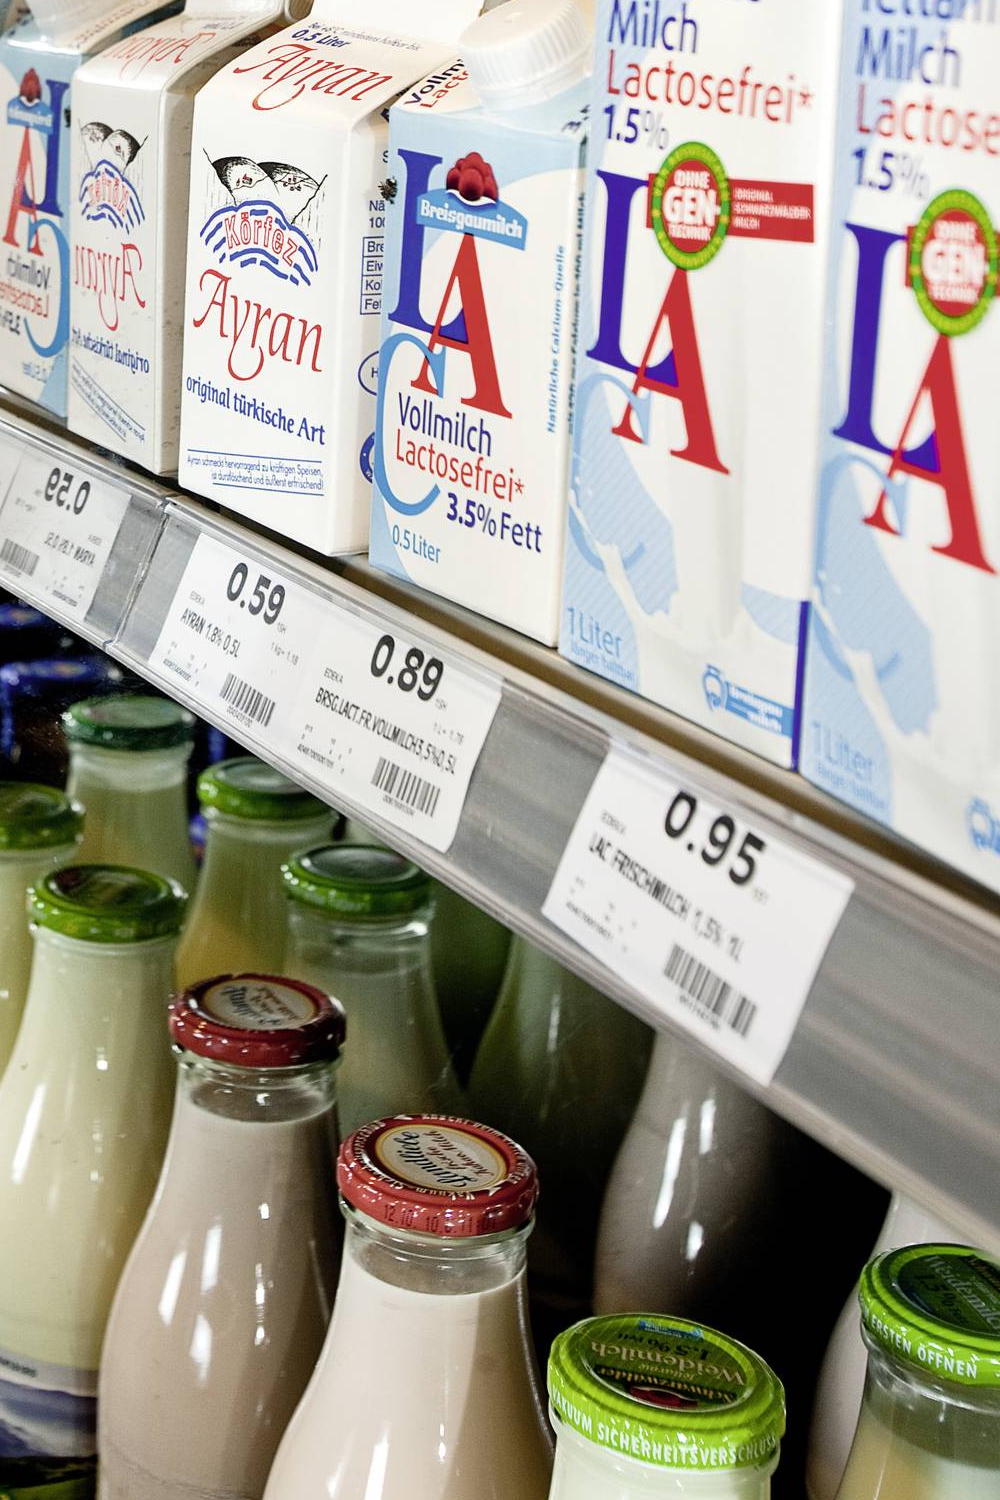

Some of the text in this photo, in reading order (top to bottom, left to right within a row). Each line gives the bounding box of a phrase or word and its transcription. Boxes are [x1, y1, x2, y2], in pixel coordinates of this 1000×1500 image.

[315, 34, 352, 48] Liter
[607, 0, 699, 55] Milch
[232, 43, 393, 111] Ayran
[856, 28, 963, 89] Milch
[673, 169, 711, 190] OHNE
[223, 211, 302, 267] Körfez
[420, 199, 524, 240] Breisgaumilch
[935, 219, 976, 243] OHNE
[192, 268, 323, 382] Ayran
[186, 376, 231, 410] original
[233, 392, 295, 434] türkische
[296, 417, 326, 446] Art
[397, 391, 492, 457] Vollmilch
[392, 523, 441, 565] 0.5 Liter
[446, 491, 543, 553] 3.5% Fett
[225, 562, 286, 625] 0.59
[180, 608, 207, 635] AYRAN
[222, 634, 241, 659] 0,5L
[579, 611, 623, 659] Liter
[323, 667, 344, 685] EDEKA
[370, 634, 444, 702] 0.89
[589, 831, 611, 862] LAC
[664, 789, 768, 887] 0.95
[393, 1130, 478, 1188] Landliebe
[422, 1130, 458, 1151] Milch
[591, 1340, 746, 1387] Weidemilch
[870, 1313, 979, 1381] ERSTEN ÖFFNEN
[552, 1385, 594, 1435] VAKUUM
